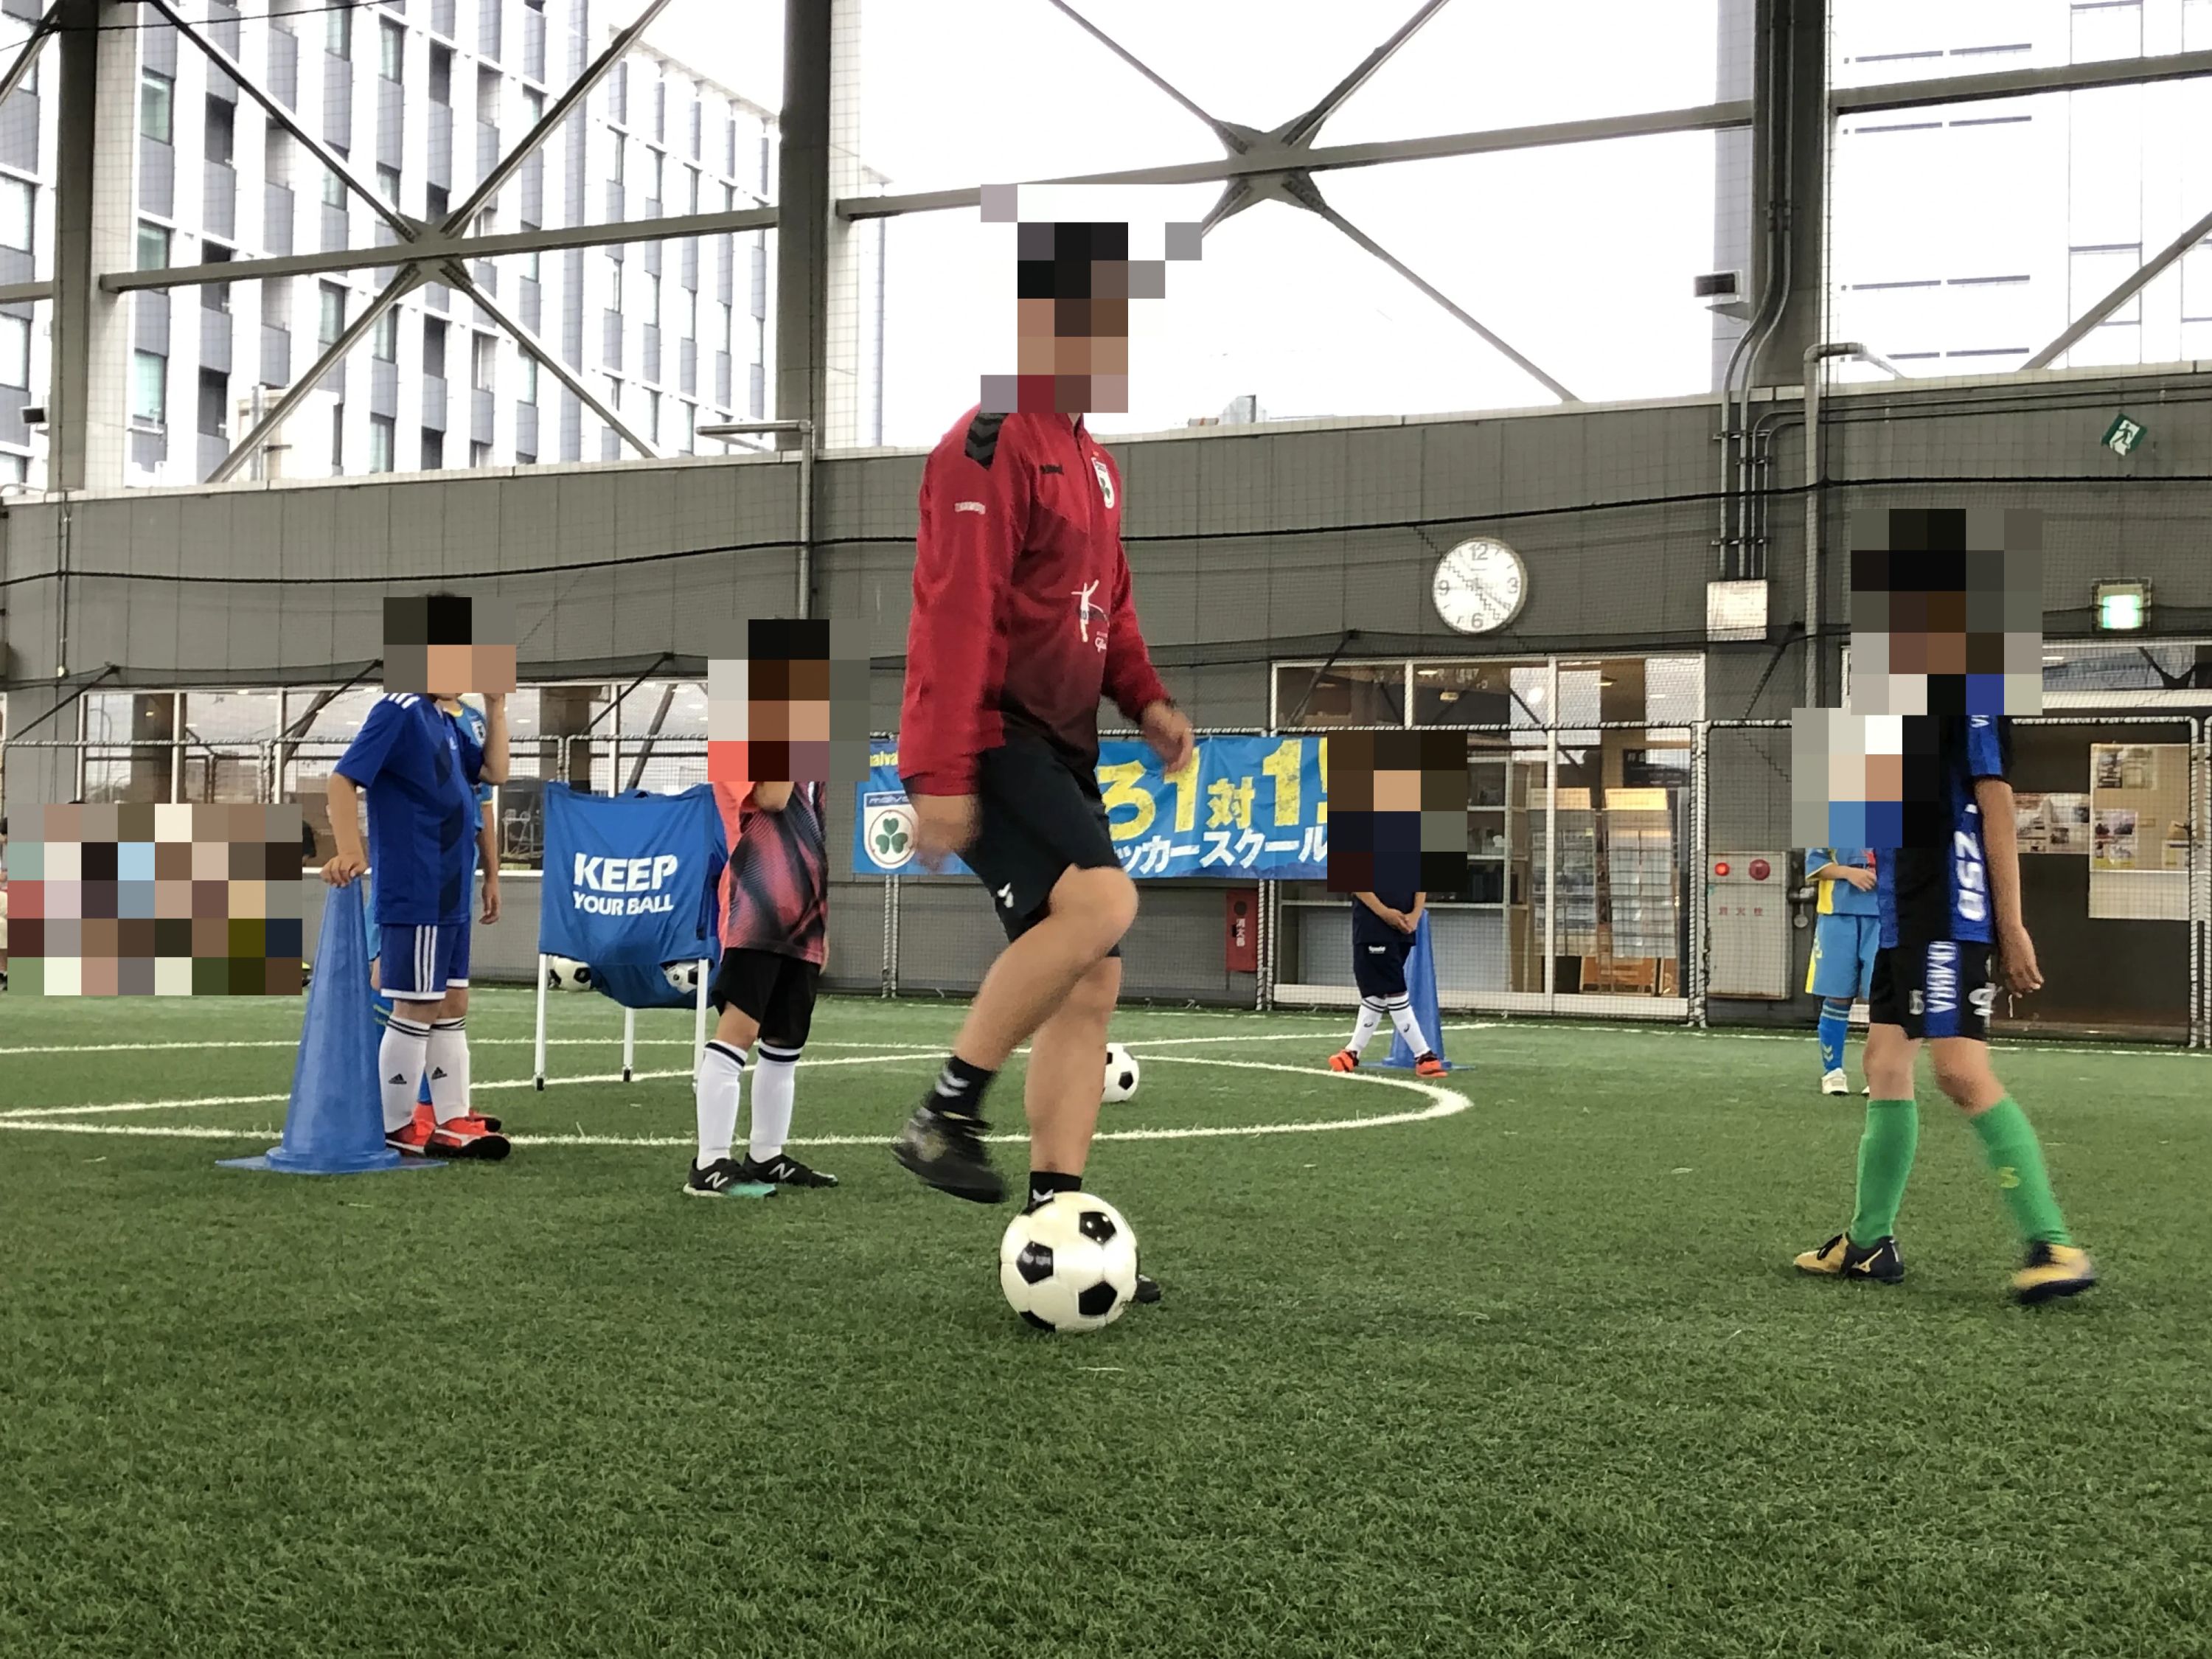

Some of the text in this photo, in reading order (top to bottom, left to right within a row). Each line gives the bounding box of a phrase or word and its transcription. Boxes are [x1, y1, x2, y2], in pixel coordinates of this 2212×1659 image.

[1468, 543, 1489, 560] 12
[1439, 580, 1450, 596] 9
[1506, 577, 1519, 594] 3
[1471, 612, 1484, 629] 6
[573, 852, 678, 893] KEEP
[573, 891, 675, 916] YOUR BALL
